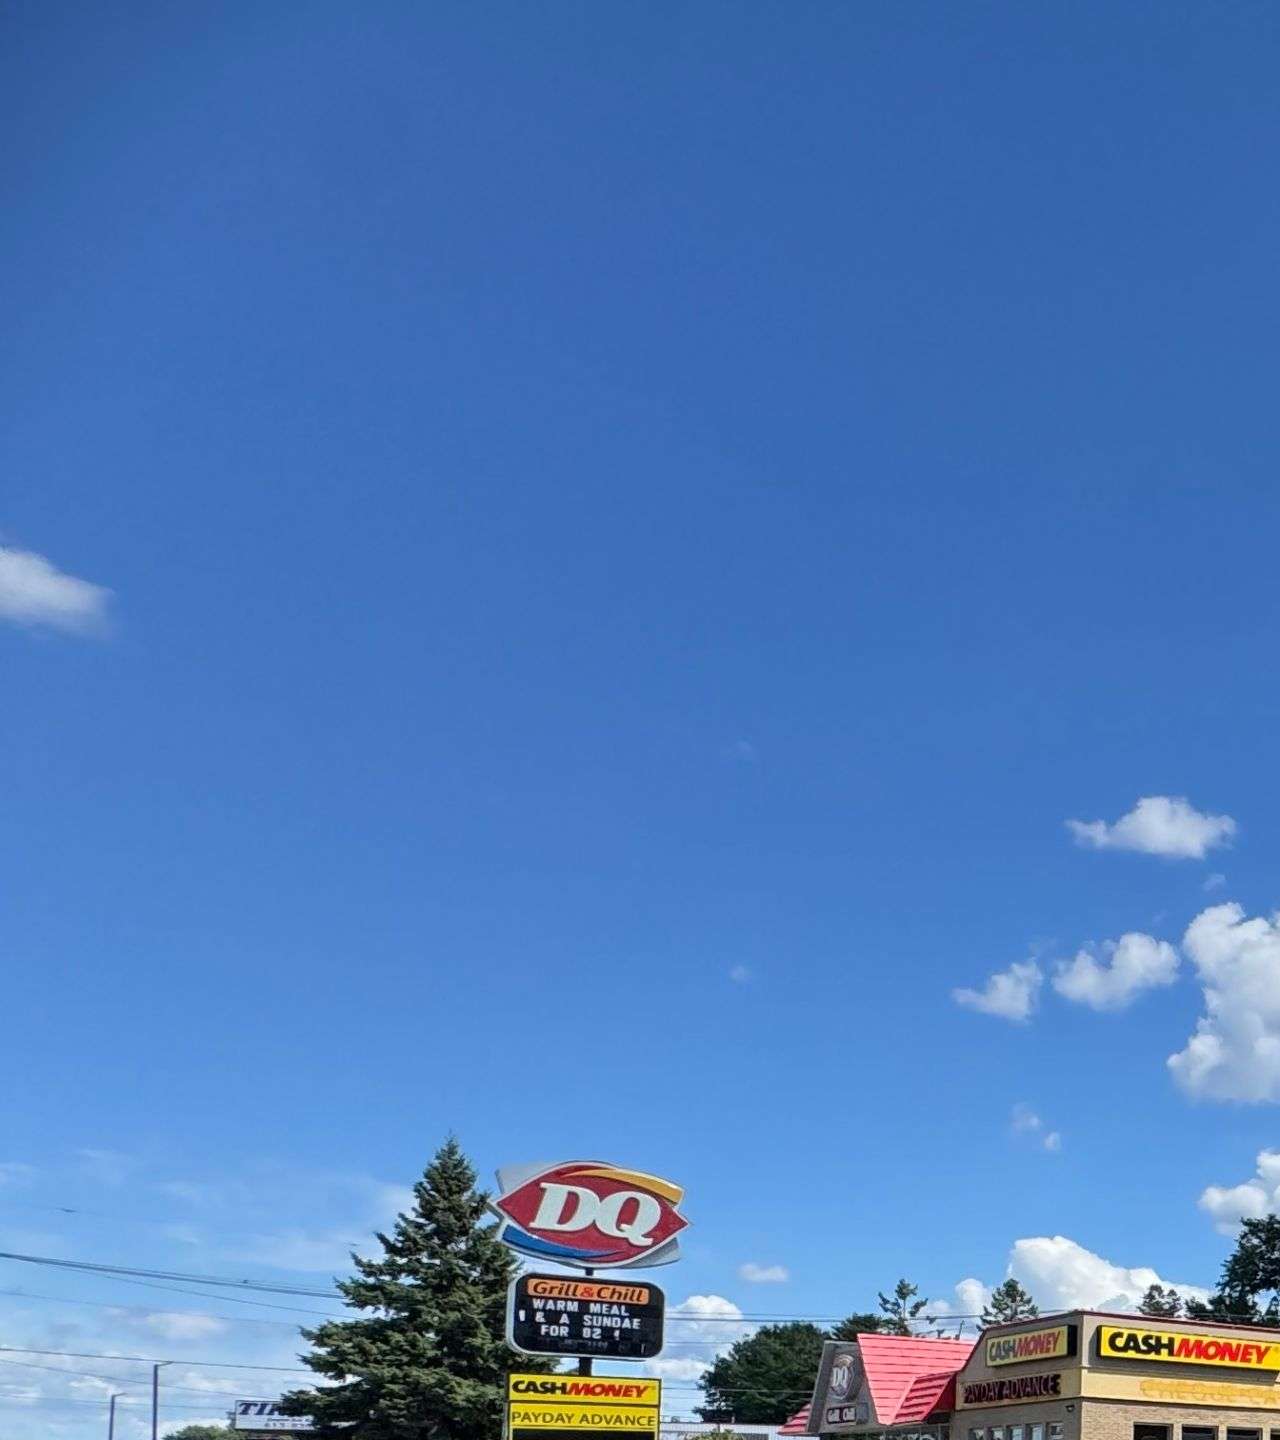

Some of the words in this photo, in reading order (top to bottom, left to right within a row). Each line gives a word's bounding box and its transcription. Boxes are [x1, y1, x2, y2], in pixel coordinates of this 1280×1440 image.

[529, 1182, 662, 1247] DQ
[533, 1281, 578, 1297] Grill
[596, 1286, 643, 1302] Chill
[532, 1298, 579, 1313] WARM
[590, 1303, 630, 1316] MEAL
[535, 1311, 546, 1323] &
[559, 1313, 570, 1325] A
[583, 1316, 641, 1329] SUNDAE
[540, 1325, 569, 1337] FOR
[963, 1378, 1002, 1404] PAYDAY
[1002, 1374, 1062, 1400] ADVANCE
[512, 1411, 574, 1425] PAYDAY
[579, 1412, 654, 1428] ADVANCE
